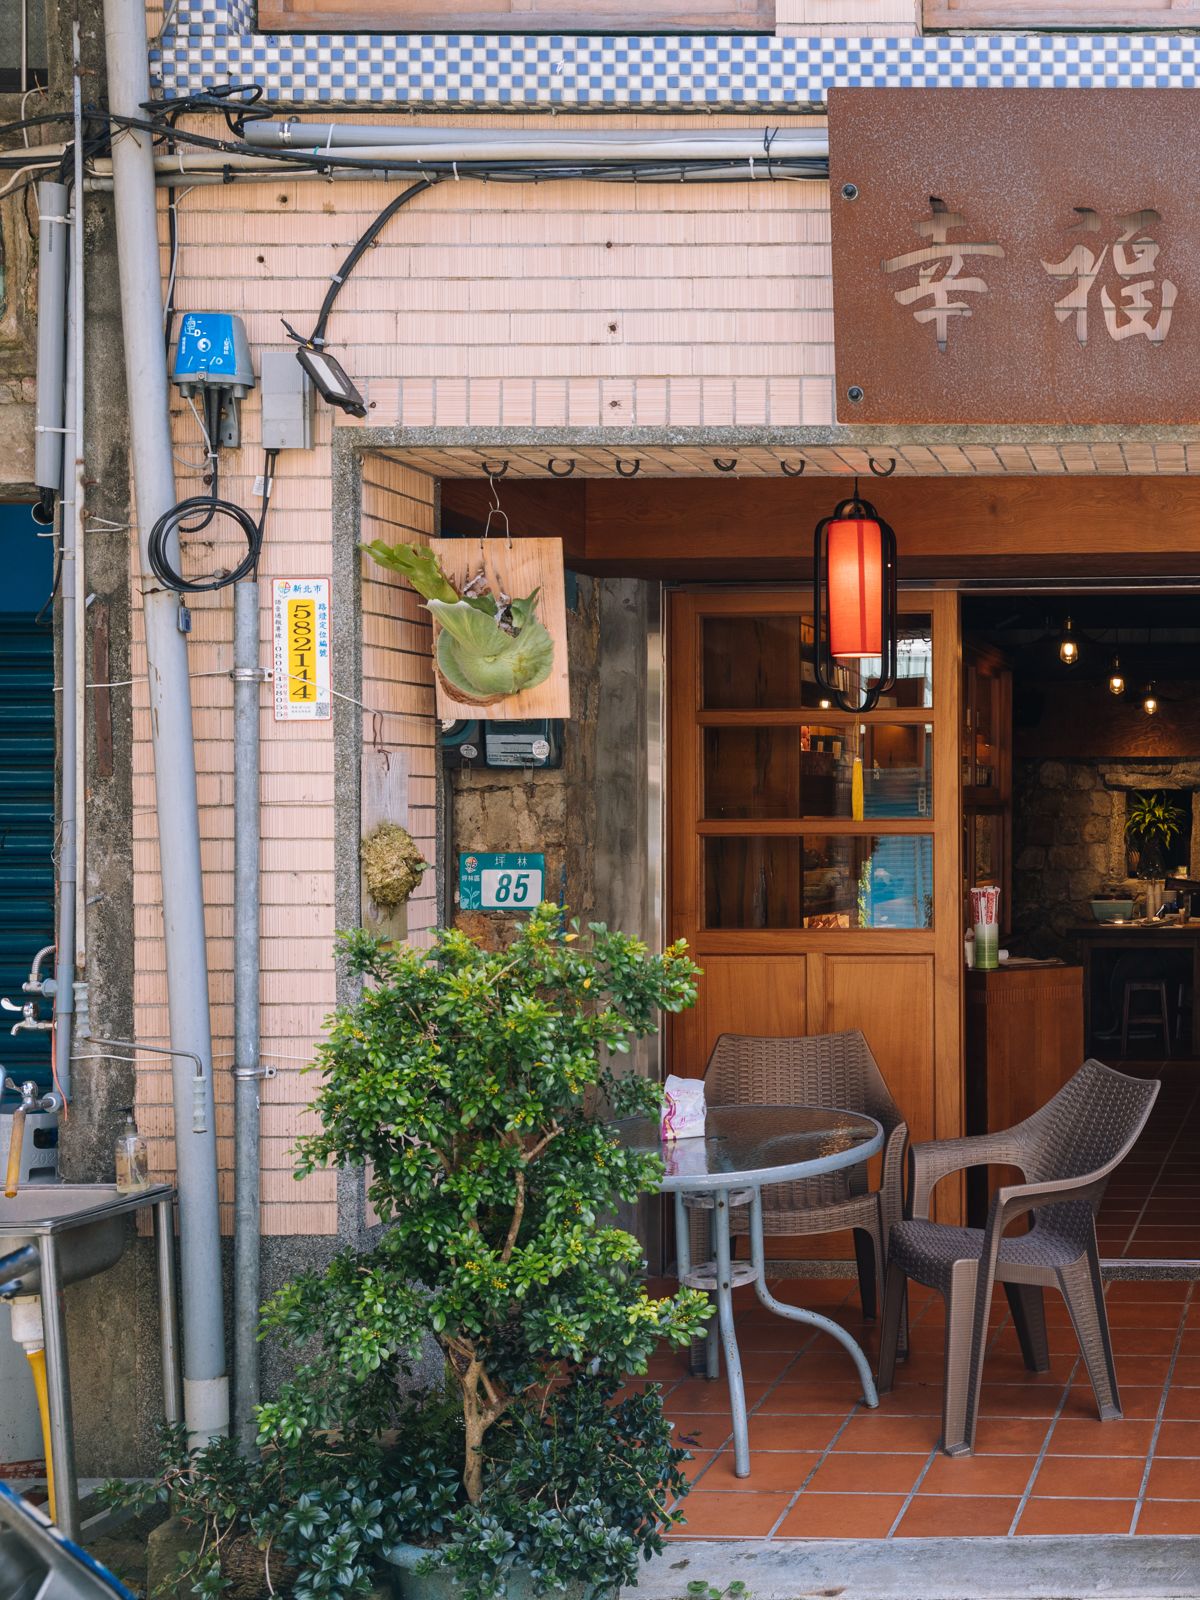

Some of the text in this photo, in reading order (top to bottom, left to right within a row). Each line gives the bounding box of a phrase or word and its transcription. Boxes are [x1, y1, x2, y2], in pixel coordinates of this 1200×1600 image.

[293, 585, 321, 594] 新北市
[292, 604, 312, 699] 582144
[495, 873, 530, 903] 85
